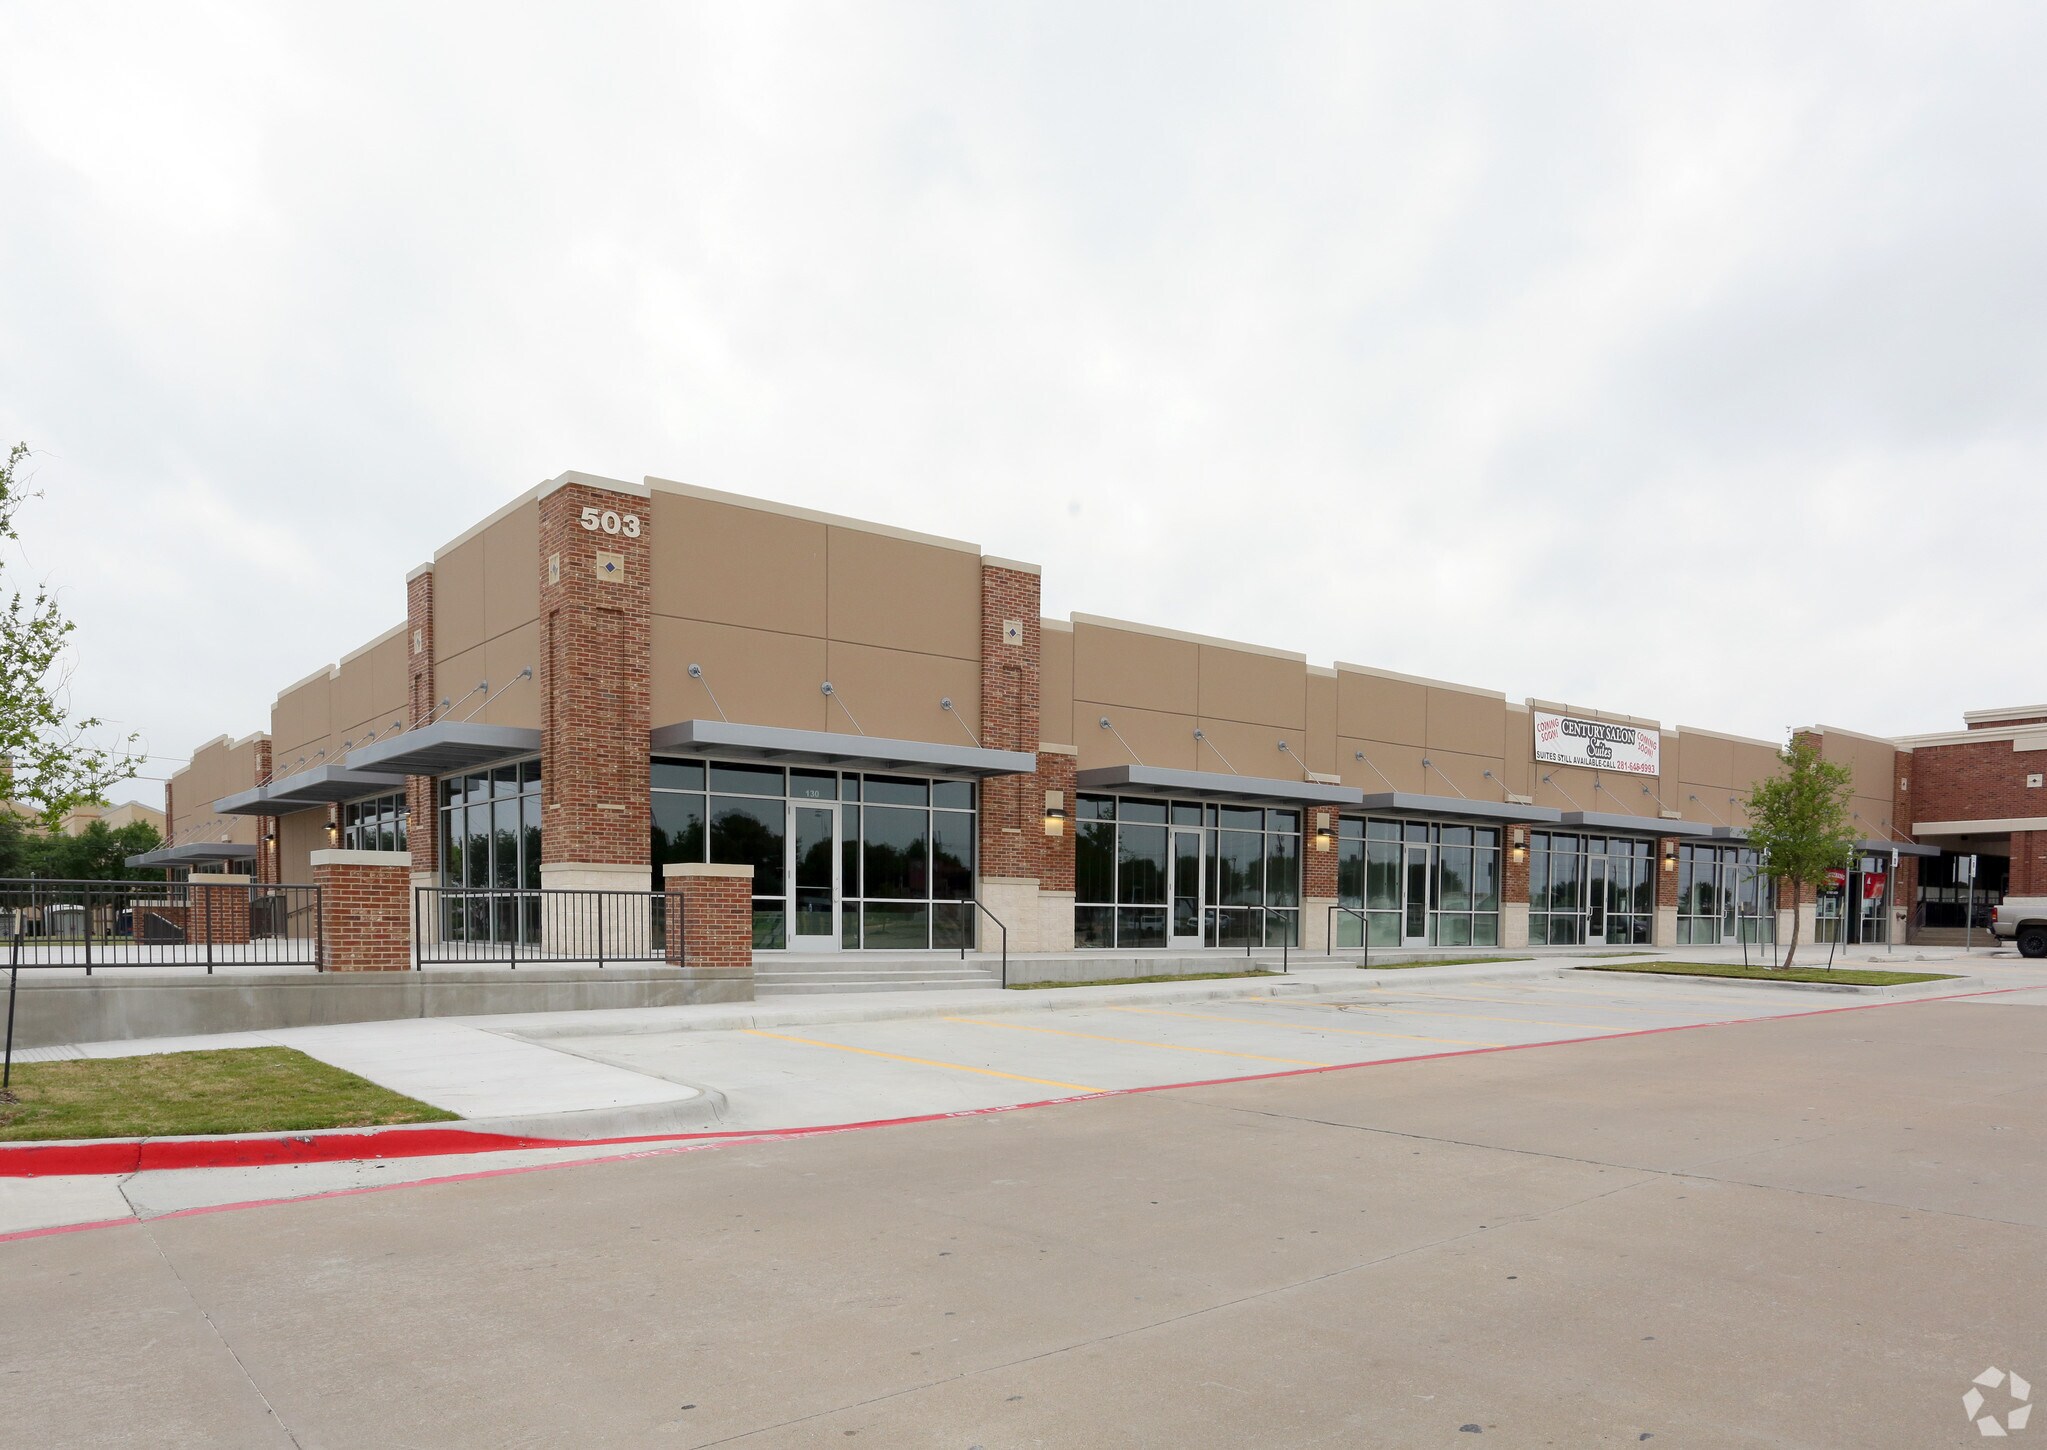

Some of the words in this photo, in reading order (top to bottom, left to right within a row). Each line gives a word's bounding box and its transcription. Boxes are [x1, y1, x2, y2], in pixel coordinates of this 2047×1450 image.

[580, 506, 641, 538] 503
[1537, 718, 1560, 733] COMING
[1562, 720, 1605, 740] CENTURY
[1605, 726, 1635, 744] SALON
[1541, 729, 1559, 742] SOON!
[1637, 732, 1658, 750] COMING
[1537, 751, 1556, 761] SUITES
[1557, 754, 1571, 763] STILL
[1587, 737, 1612, 759] Suites
